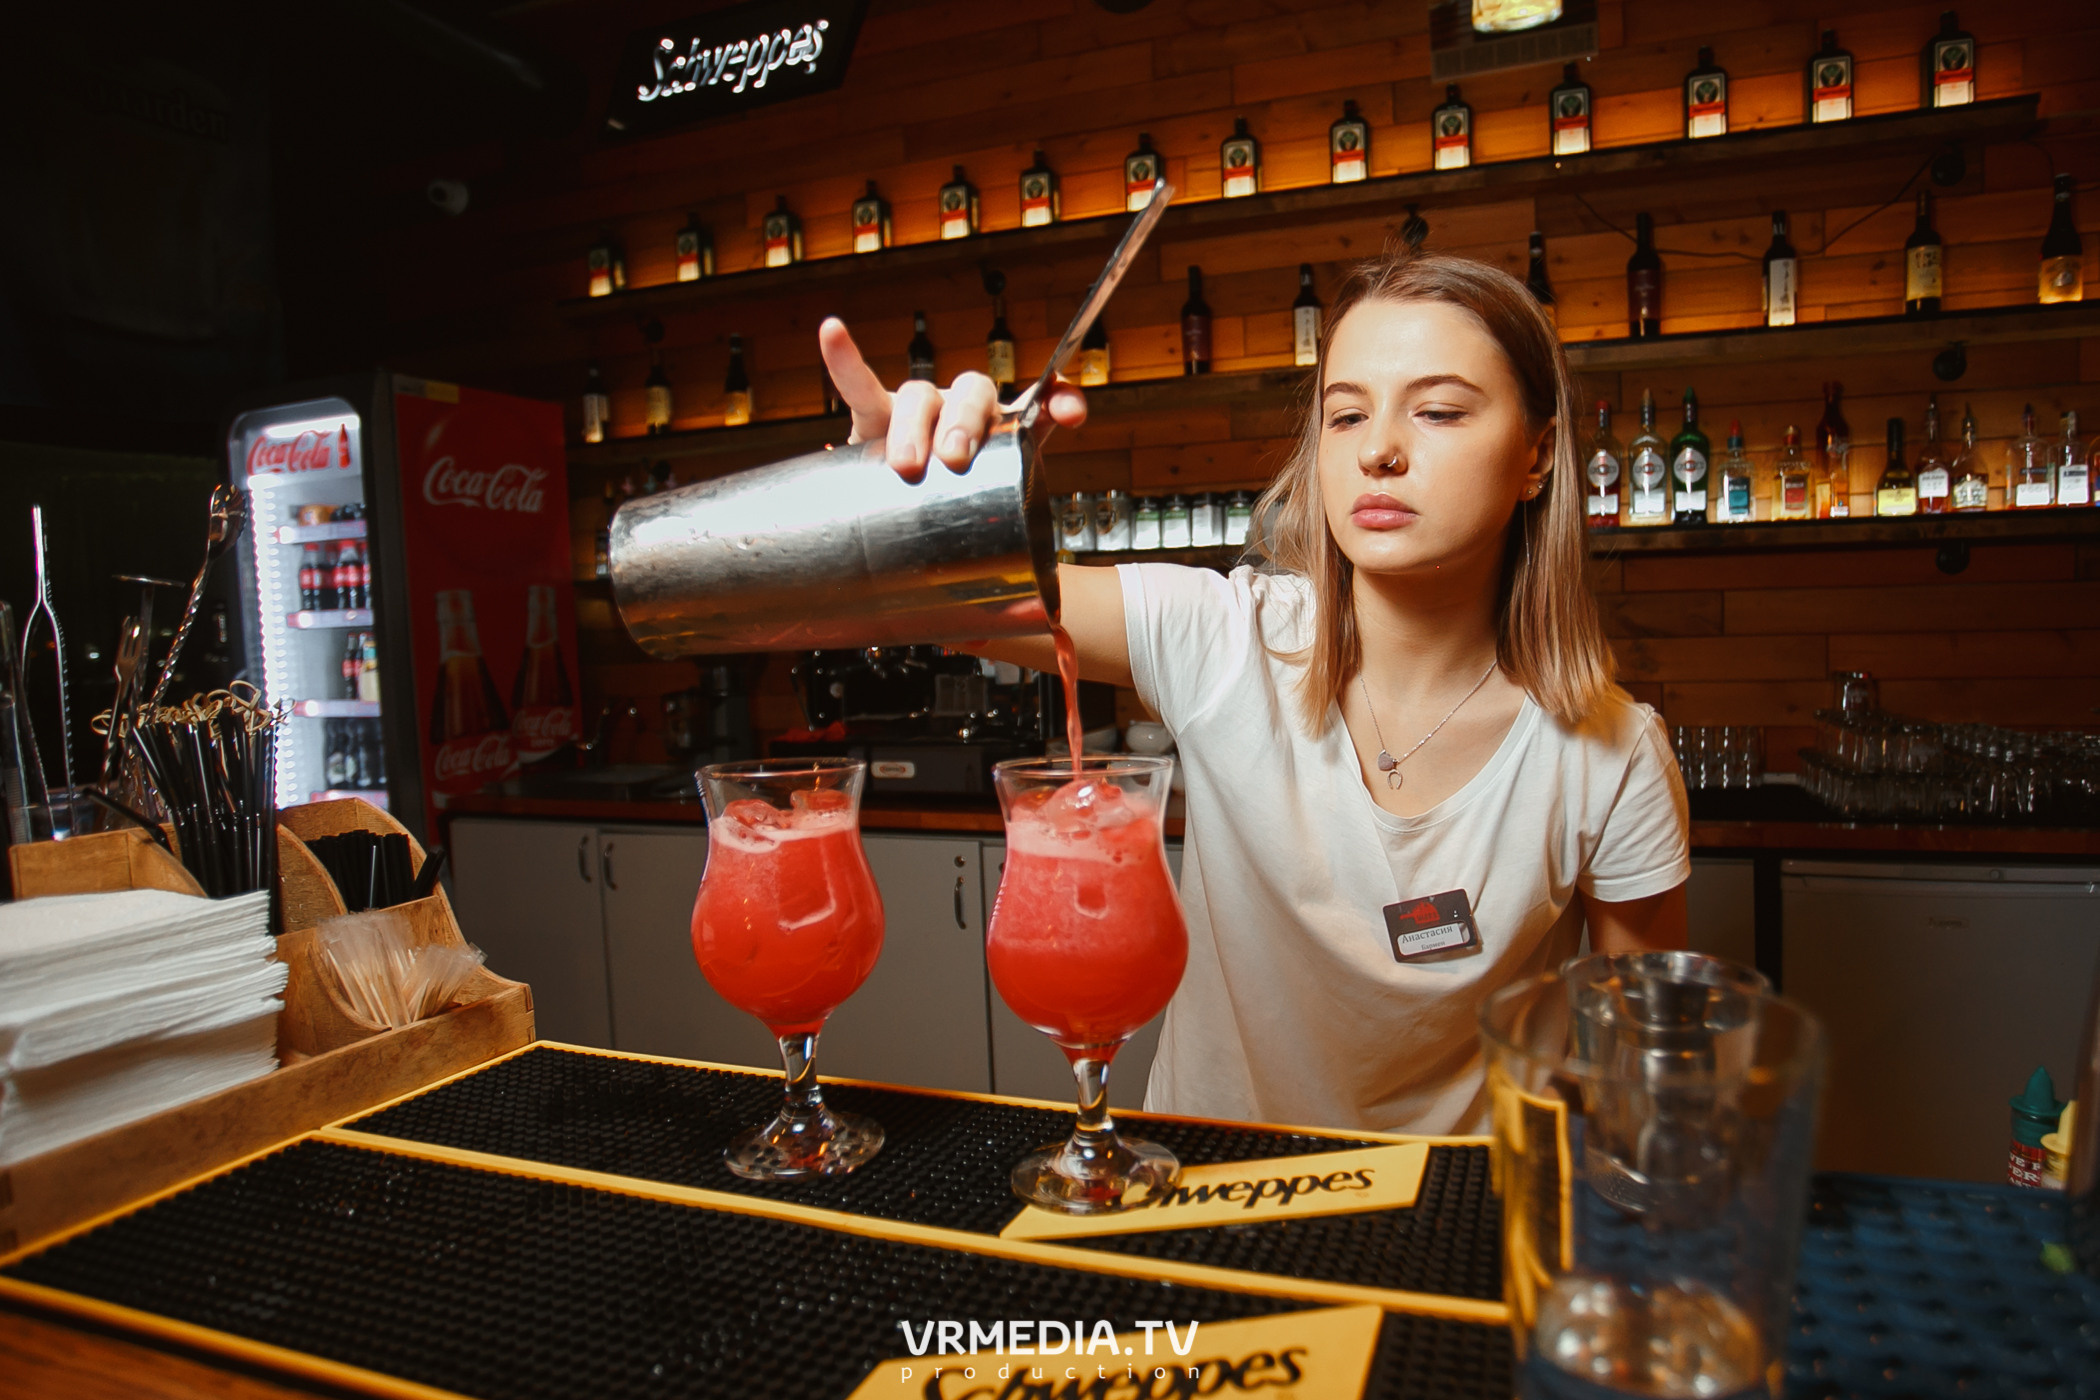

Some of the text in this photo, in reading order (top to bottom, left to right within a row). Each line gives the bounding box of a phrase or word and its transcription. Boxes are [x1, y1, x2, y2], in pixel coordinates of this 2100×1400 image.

[637, 19, 829, 102] Schweppes
[423, 456, 548, 512] Coca-Cola
[1402, 926, 1453, 944] Анастасия
